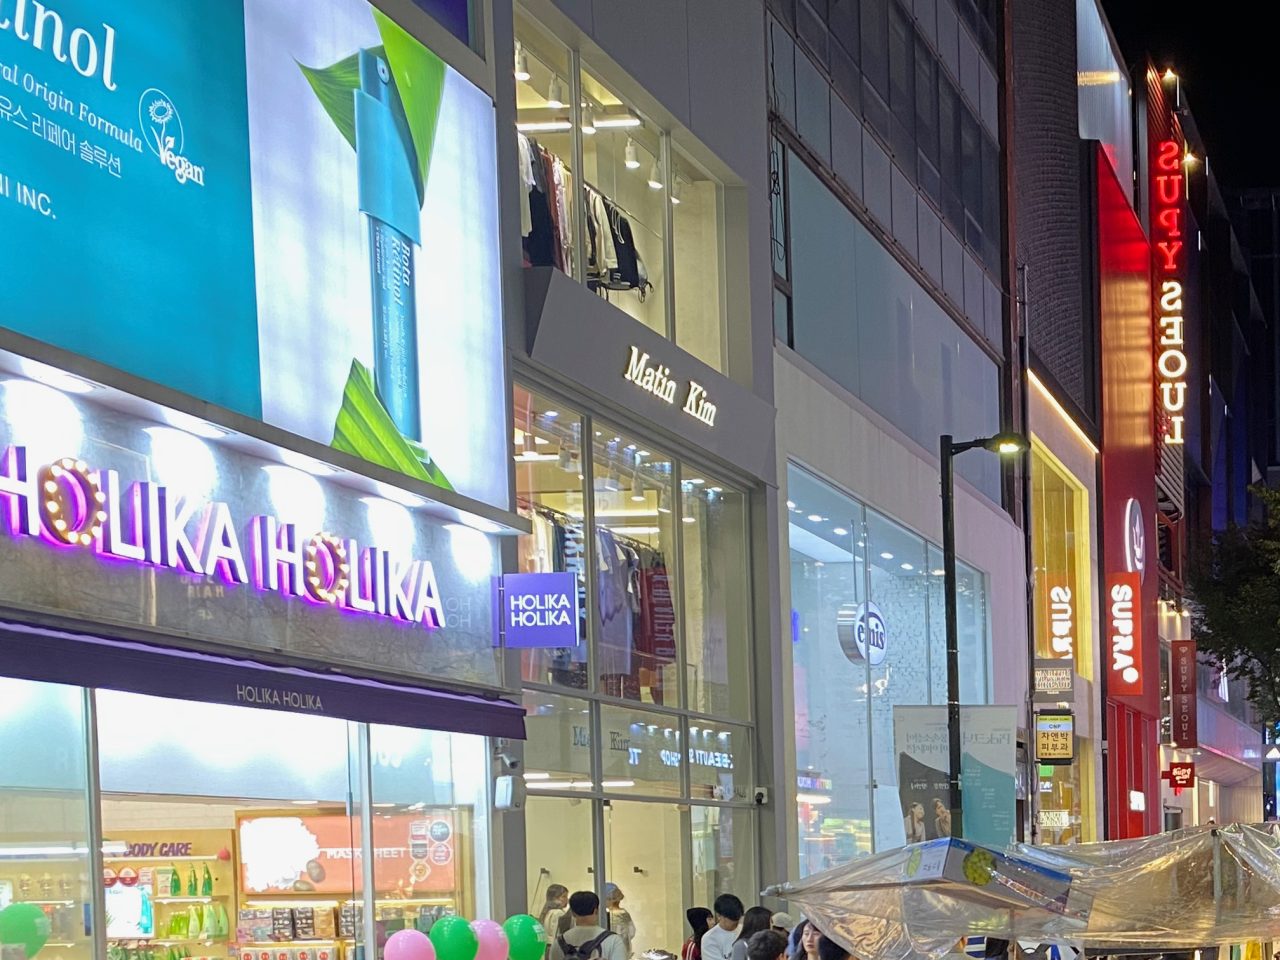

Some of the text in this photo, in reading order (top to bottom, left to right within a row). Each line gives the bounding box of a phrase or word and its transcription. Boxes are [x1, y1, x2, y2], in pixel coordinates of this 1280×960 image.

[0, 0, 117, 91] inol
[23, 73, 74, 116] Origin
[79, 102, 143, 153] Formula
[32, 112, 76, 155] 리페어
[80, 139, 122, 178] 솔루션
[151, 126, 205, 186] Vegan
[16, 182, 57, 219] INC.
[624, 345, 717, 427] Matin Kim
[0, 440, 446, 629] HOLIKA HOLIKA
[510, 594, 571, 611] HOLIKA
[510, 609, 572, 628] HOLIKA
[1111, 583, 1134, 671] SUPRA
[236, 684, 323, 711] HOLIKA HOLIKA
[1041, 742, 1068, 752] 피부과
[159, 842, 192, 856] CARE
